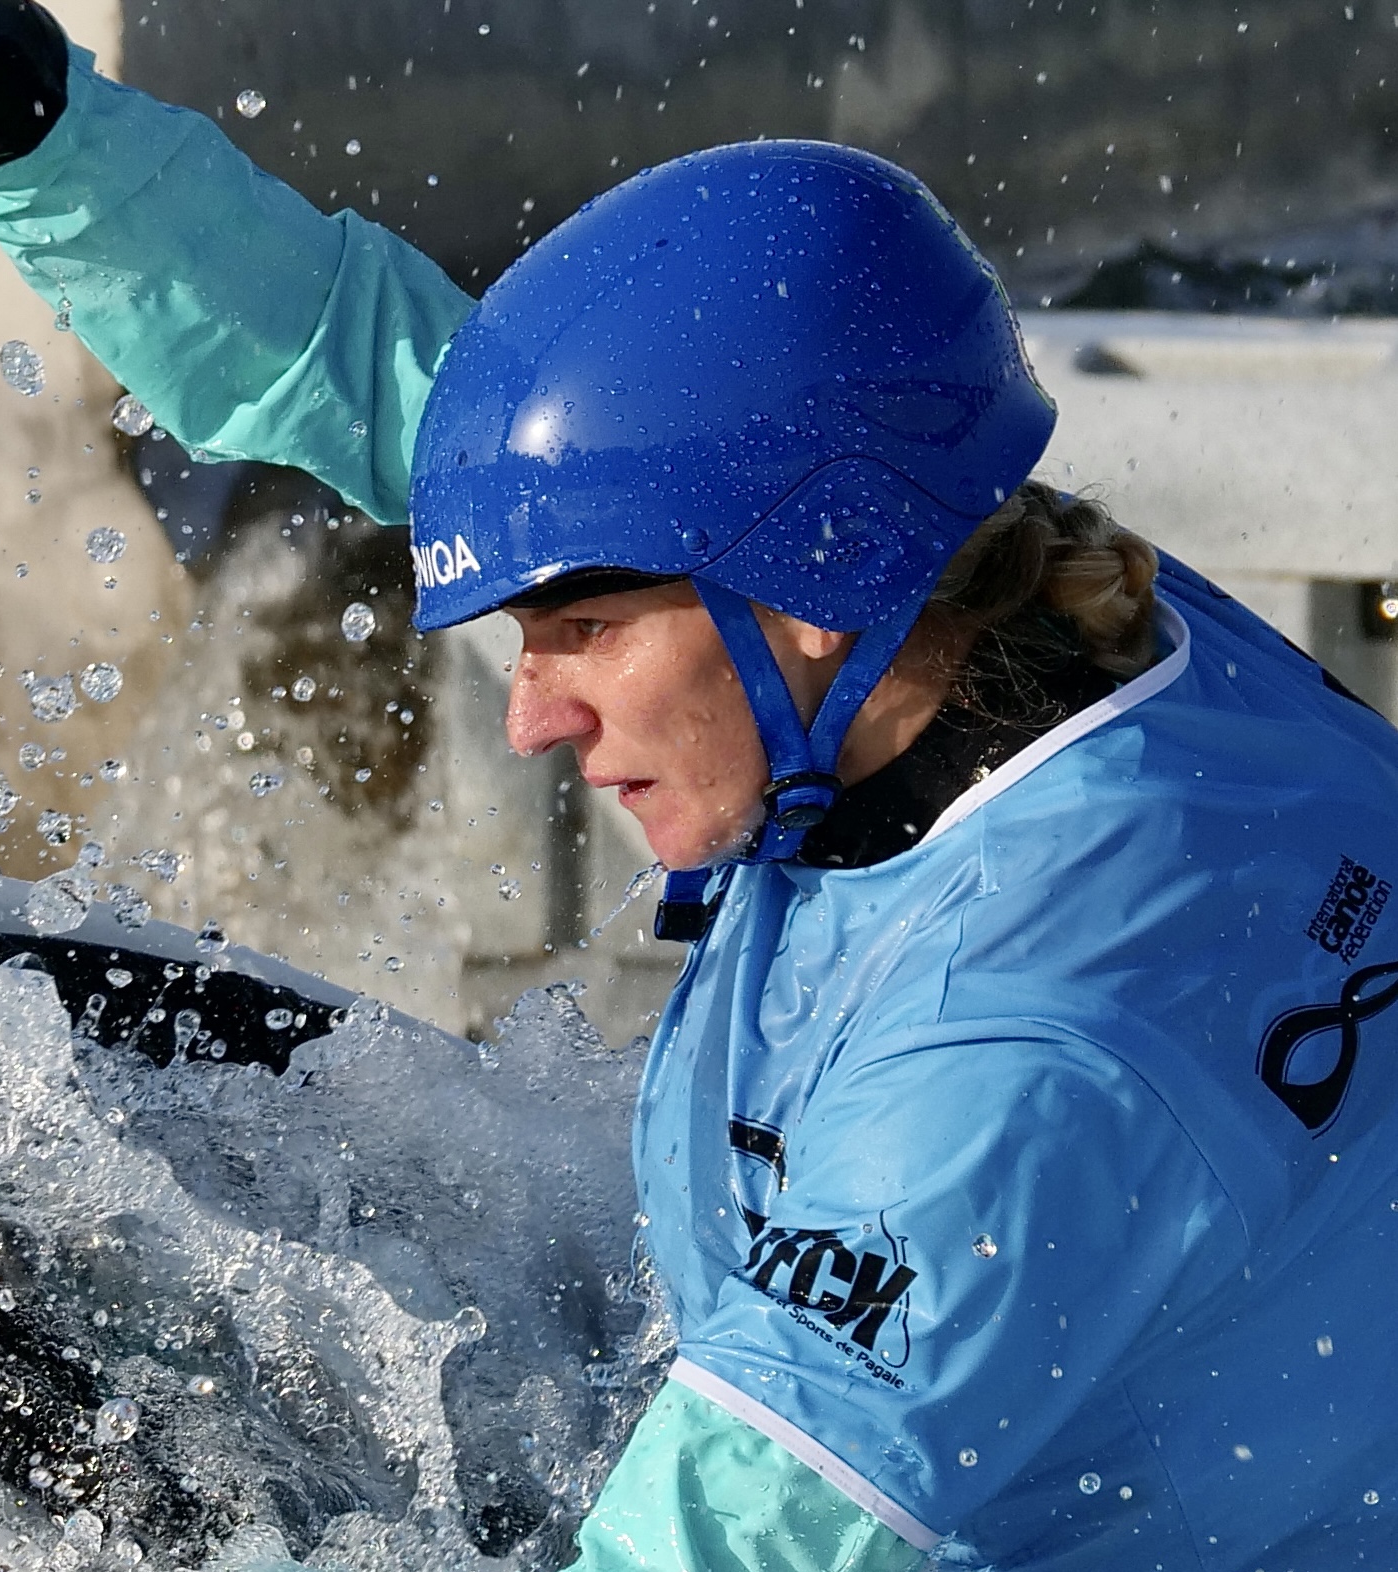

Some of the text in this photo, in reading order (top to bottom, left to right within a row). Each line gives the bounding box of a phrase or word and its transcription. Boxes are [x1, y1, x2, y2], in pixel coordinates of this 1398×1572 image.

[410, 534, 481, 588] NIQA
[1303, 853, 1355, 941] international
[1319, 865, 1376, 954] canoe
[1339, 880, 1393, 966] federation
[788, 1305, 905, 1389] Sports de Pagaie
